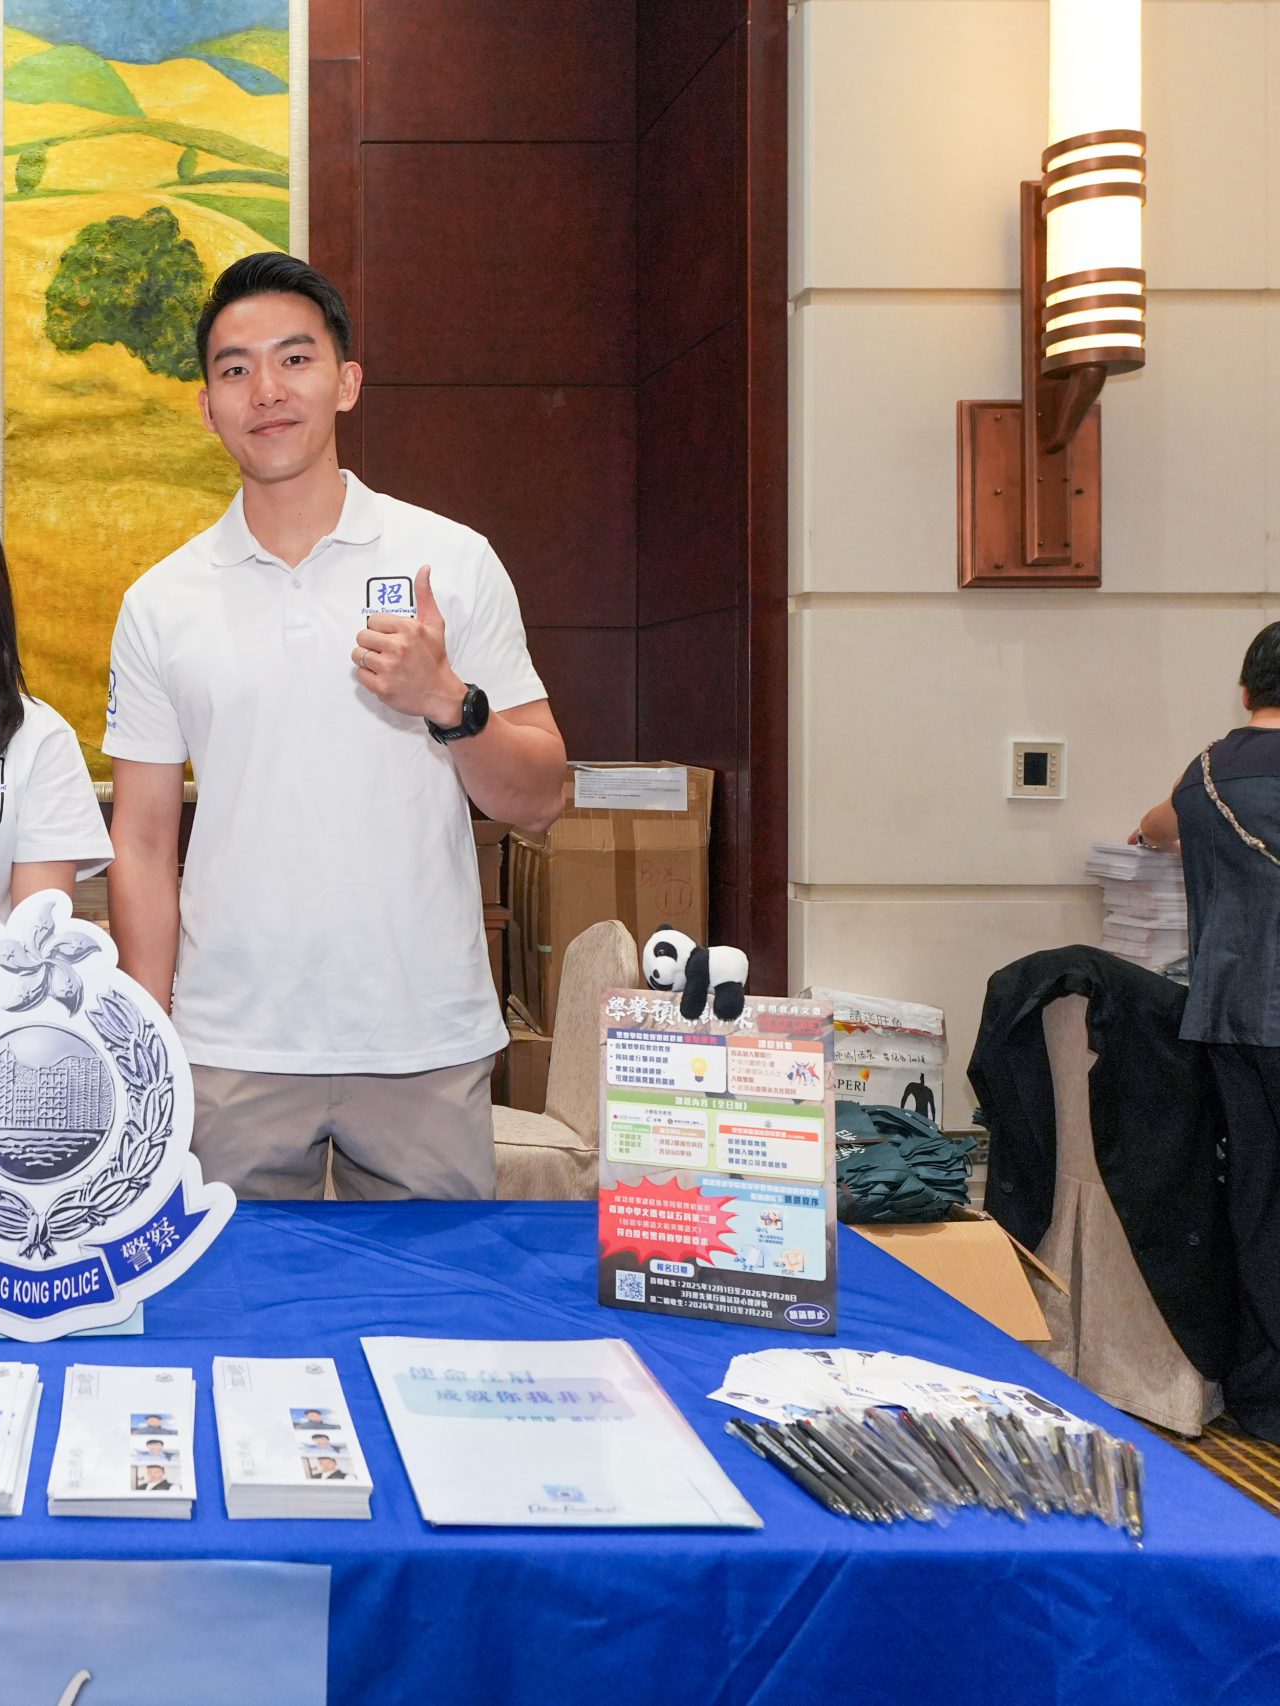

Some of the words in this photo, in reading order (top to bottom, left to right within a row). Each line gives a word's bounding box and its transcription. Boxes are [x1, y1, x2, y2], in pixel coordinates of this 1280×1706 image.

[377, 583, 402, 605] 招
[120, 1216, 180, 1272] 警察
[13, 1279, 50, 1305] KONG
[53, 1268, 101, 1301] POLICE
